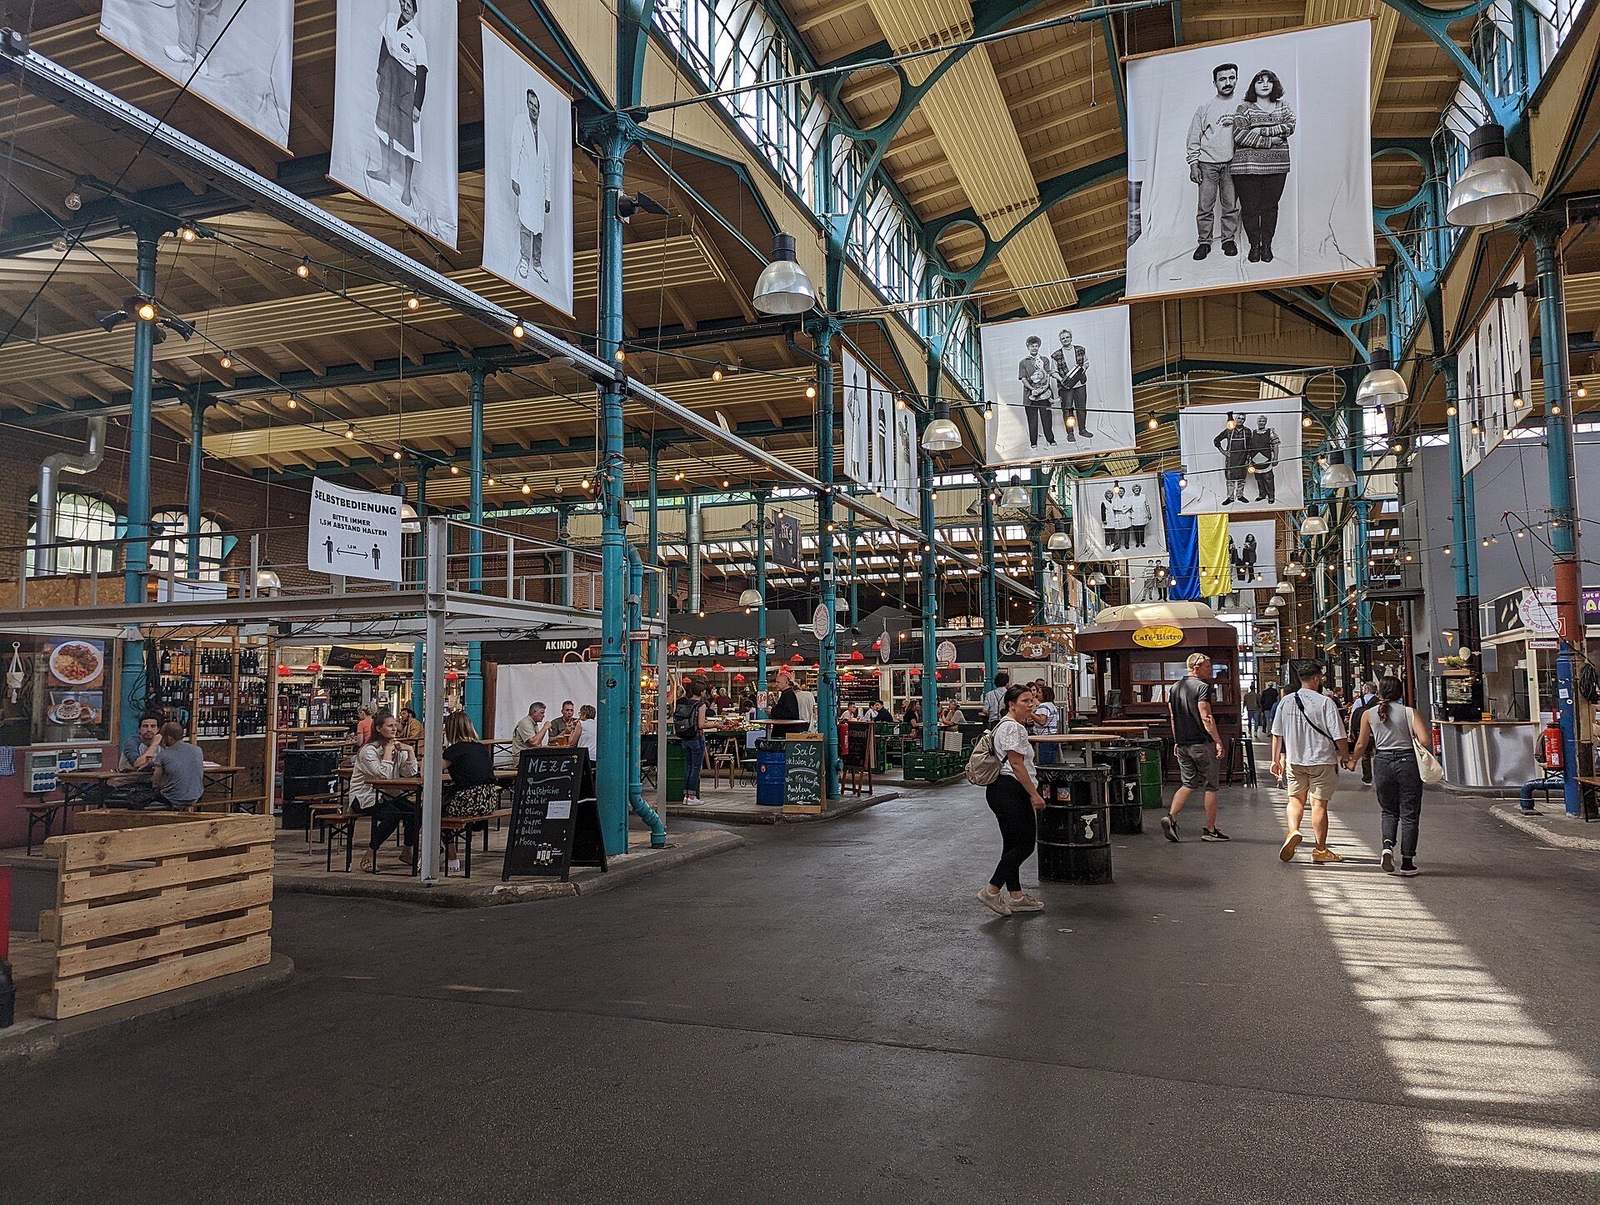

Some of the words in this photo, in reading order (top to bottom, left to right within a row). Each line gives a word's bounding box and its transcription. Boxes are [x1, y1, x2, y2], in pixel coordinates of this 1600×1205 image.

[314, 490, 396, 514] SELBSTBEDIENUNG
[332, 514, 348, 522] BITTE
[349, 517, 371, 527] IMMER
[333, 522, 360, 532] ABSTAND
[362, 529, 388, 537] HALTEN
[545, 640, 578, 650] AKINDO
[677, 638, 776, 657] KANTINE
[528, 758, 570, 772] MEZE
